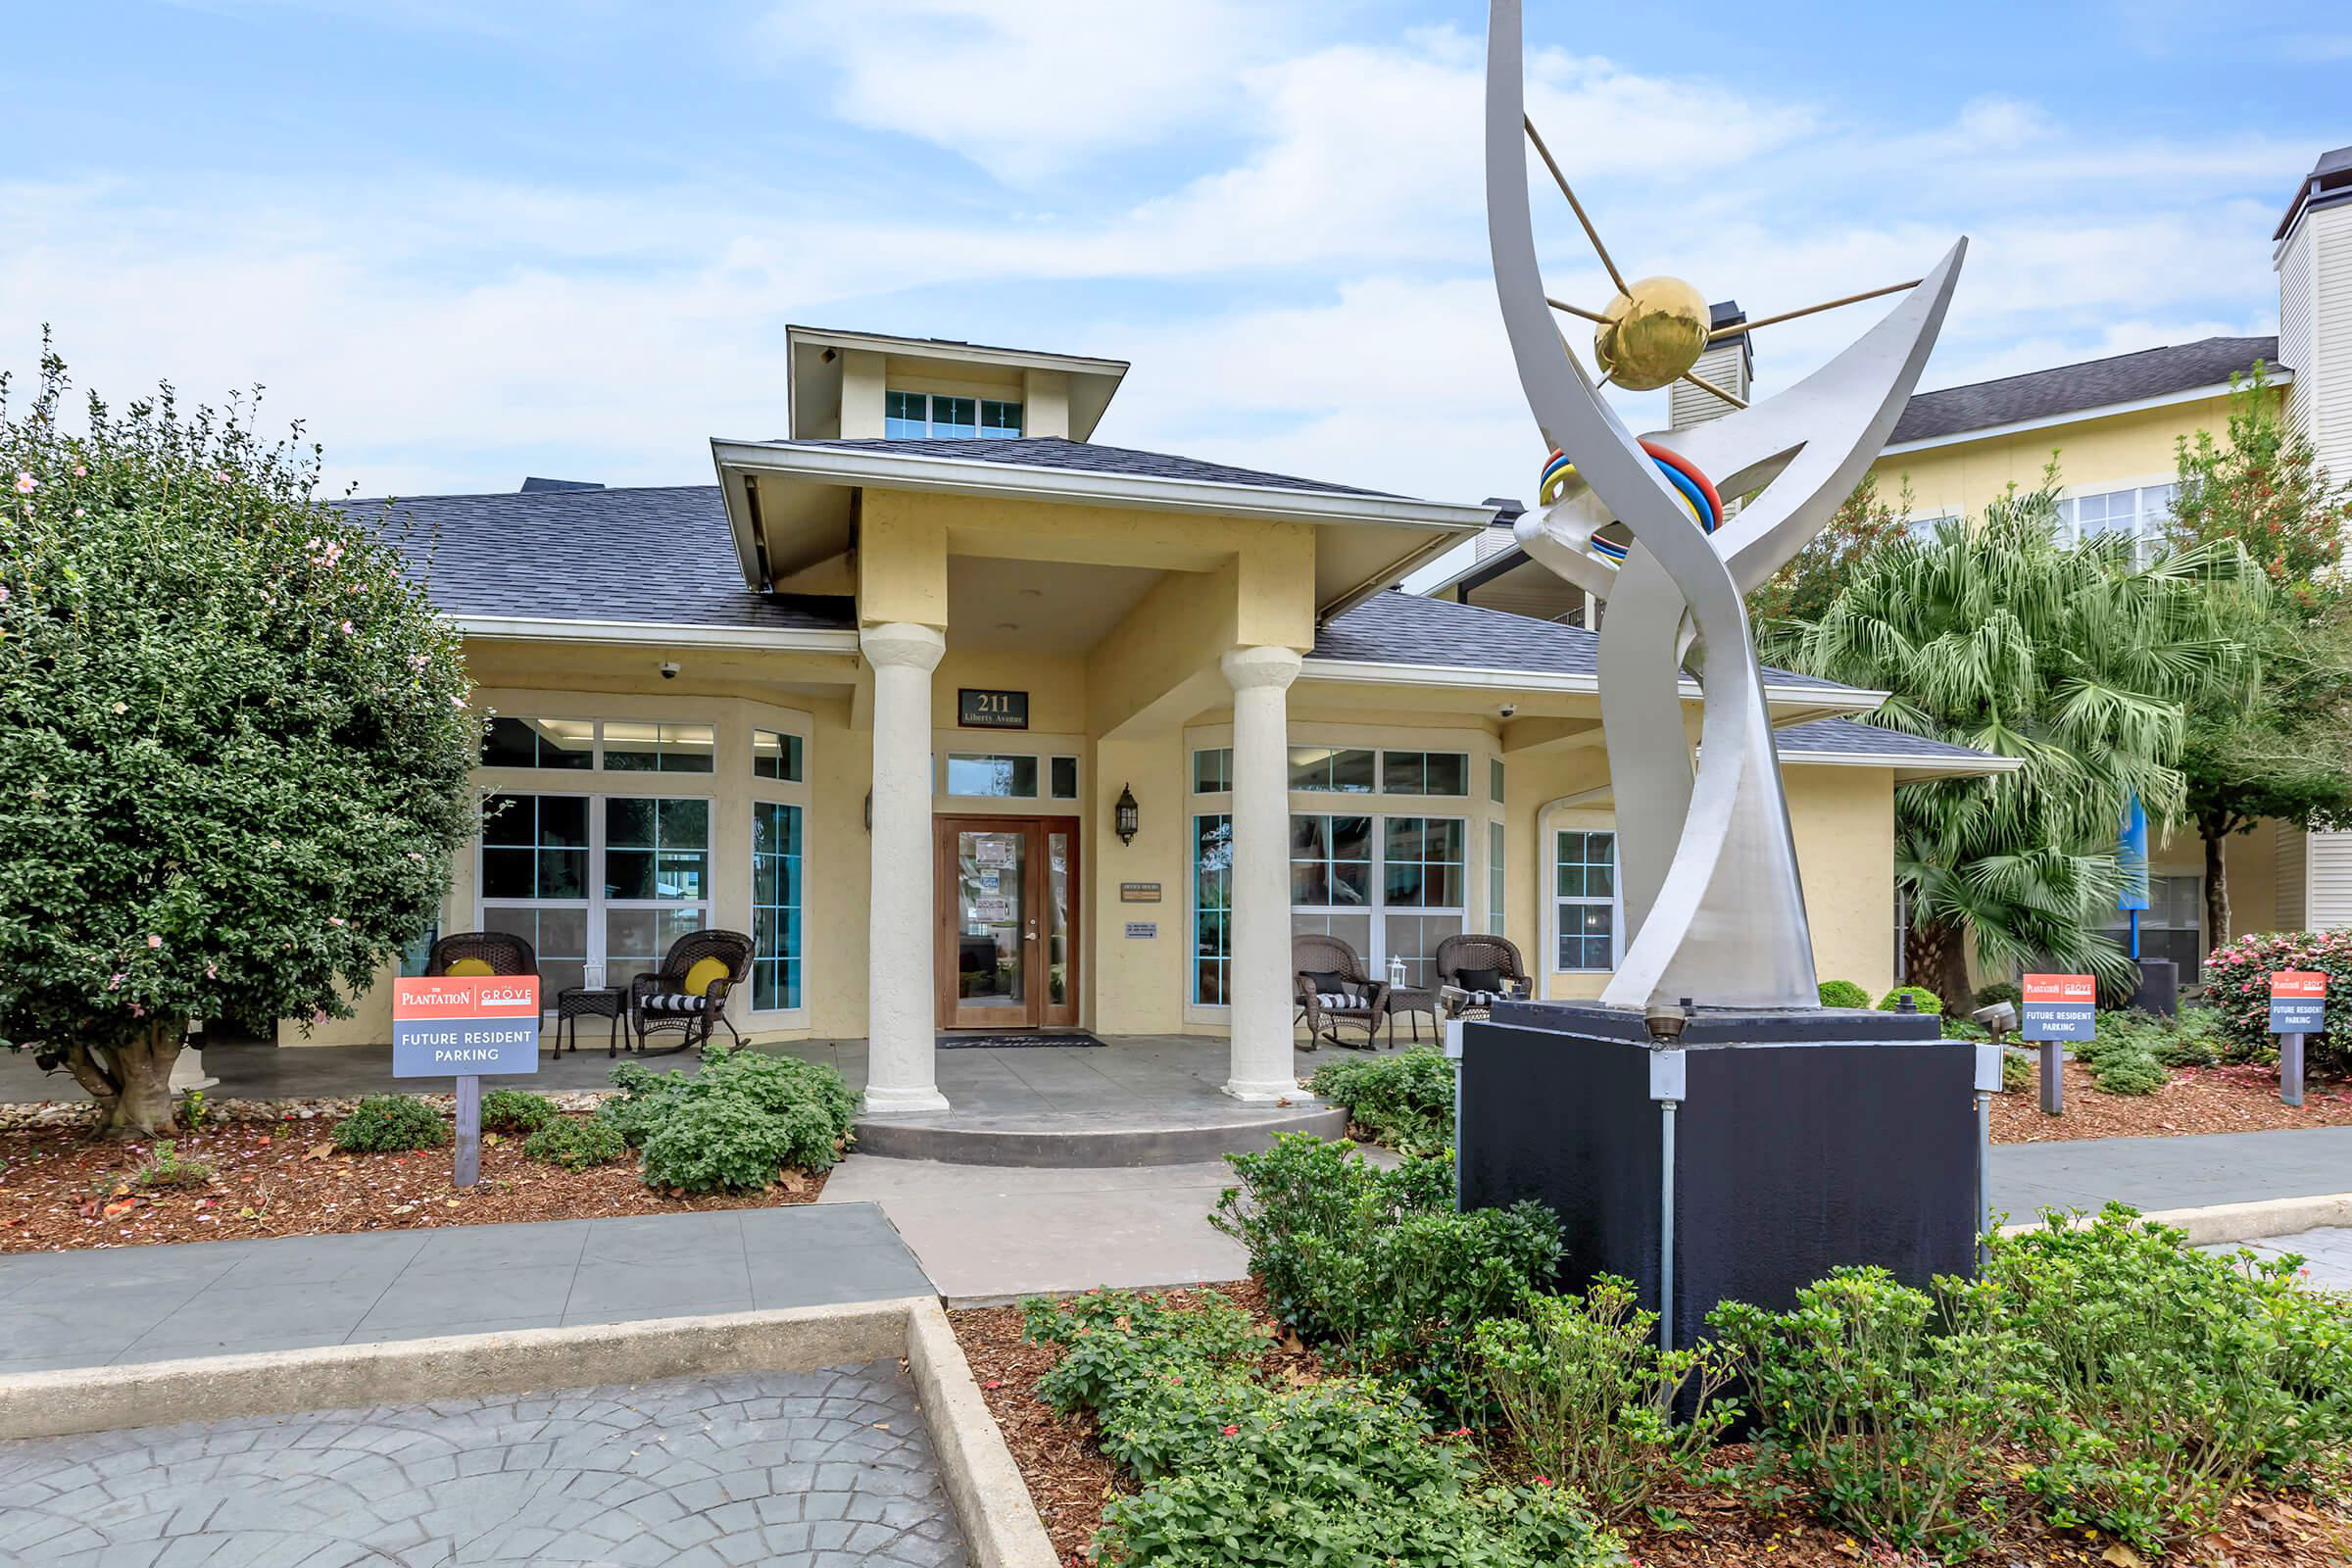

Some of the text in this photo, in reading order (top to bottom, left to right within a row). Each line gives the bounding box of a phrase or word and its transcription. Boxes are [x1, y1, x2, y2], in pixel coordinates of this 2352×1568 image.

[977, 694, 1008, 712] 211
[964, 713, 992, 723] Liberty
[402, 992, 469, 1005] PLANTATION
[481, 989, 532, 1000] GROVE
[402, 1031, 531, 1046] FUTURE RESIDENT
[435, 1050, 499, 1061] PARKING
